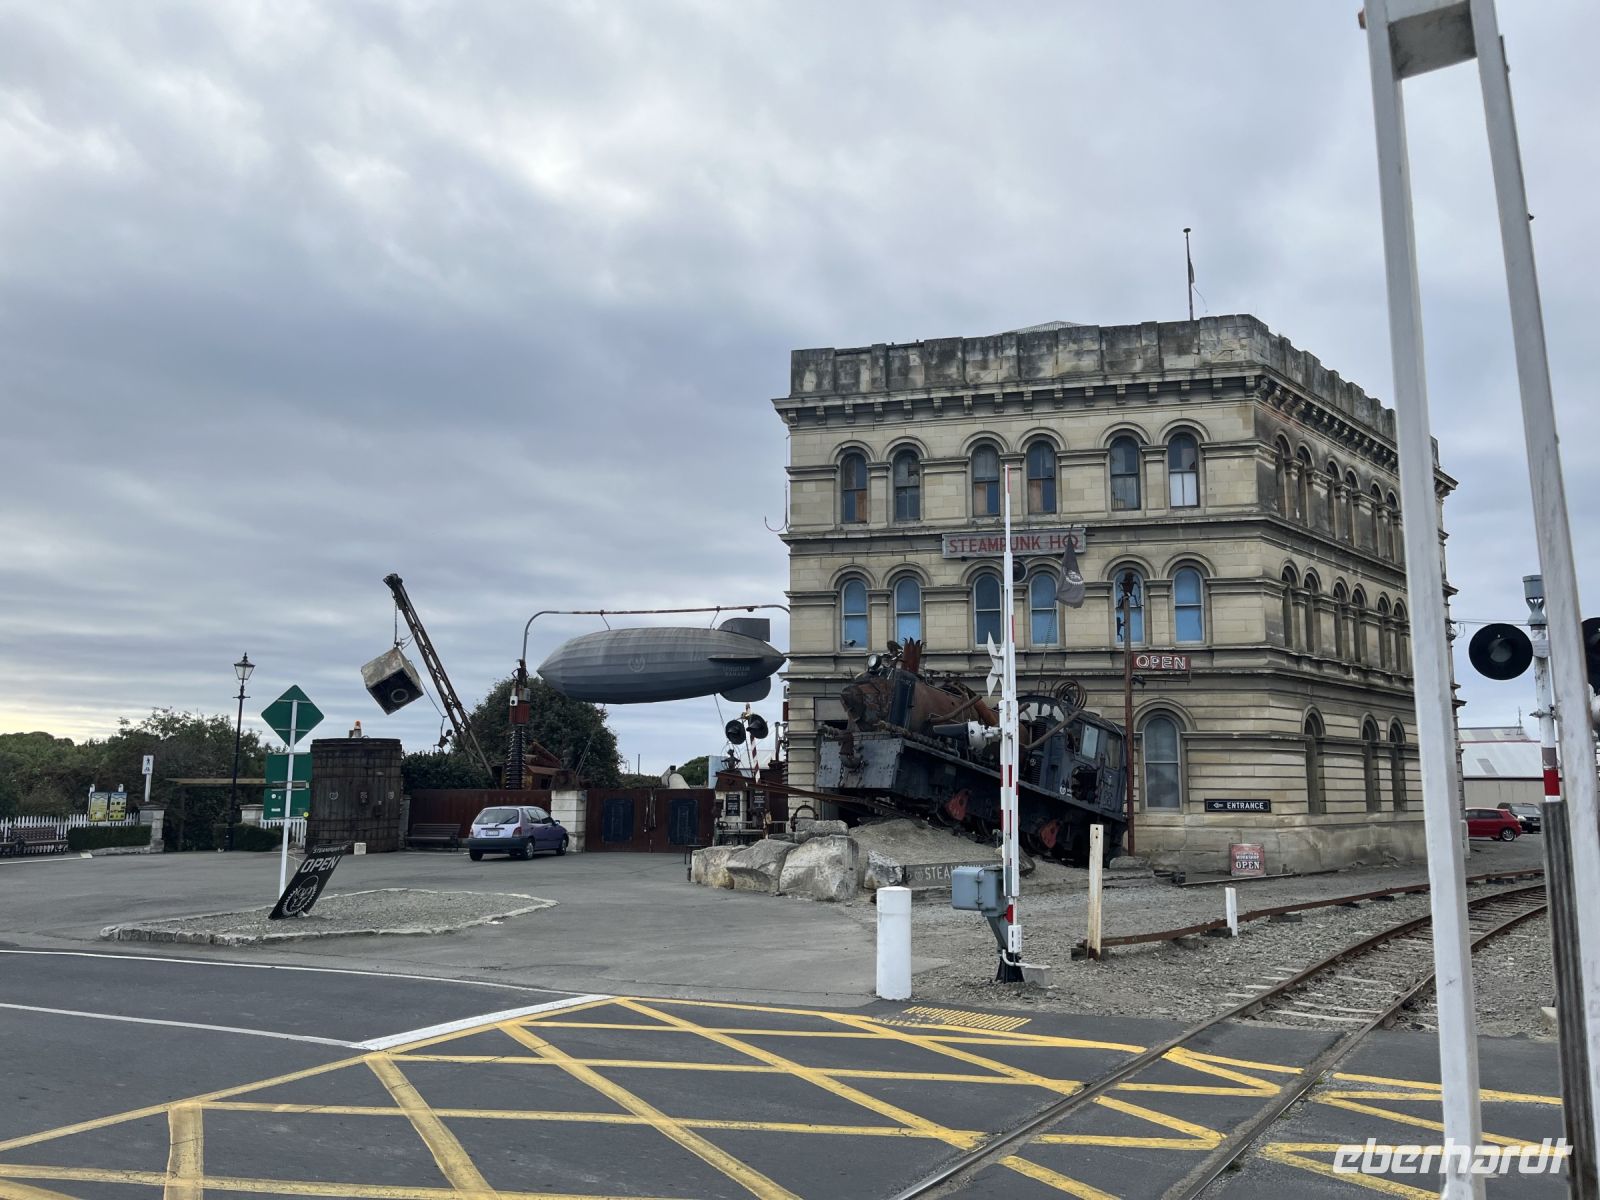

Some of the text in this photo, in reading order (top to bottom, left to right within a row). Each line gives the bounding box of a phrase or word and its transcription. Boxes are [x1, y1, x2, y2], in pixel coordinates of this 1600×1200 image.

[1136, 655, 1186, 669] OPEN
[301, 856, 340, 873] OPEN
[1235, 861, 1260, 869] OPEN
